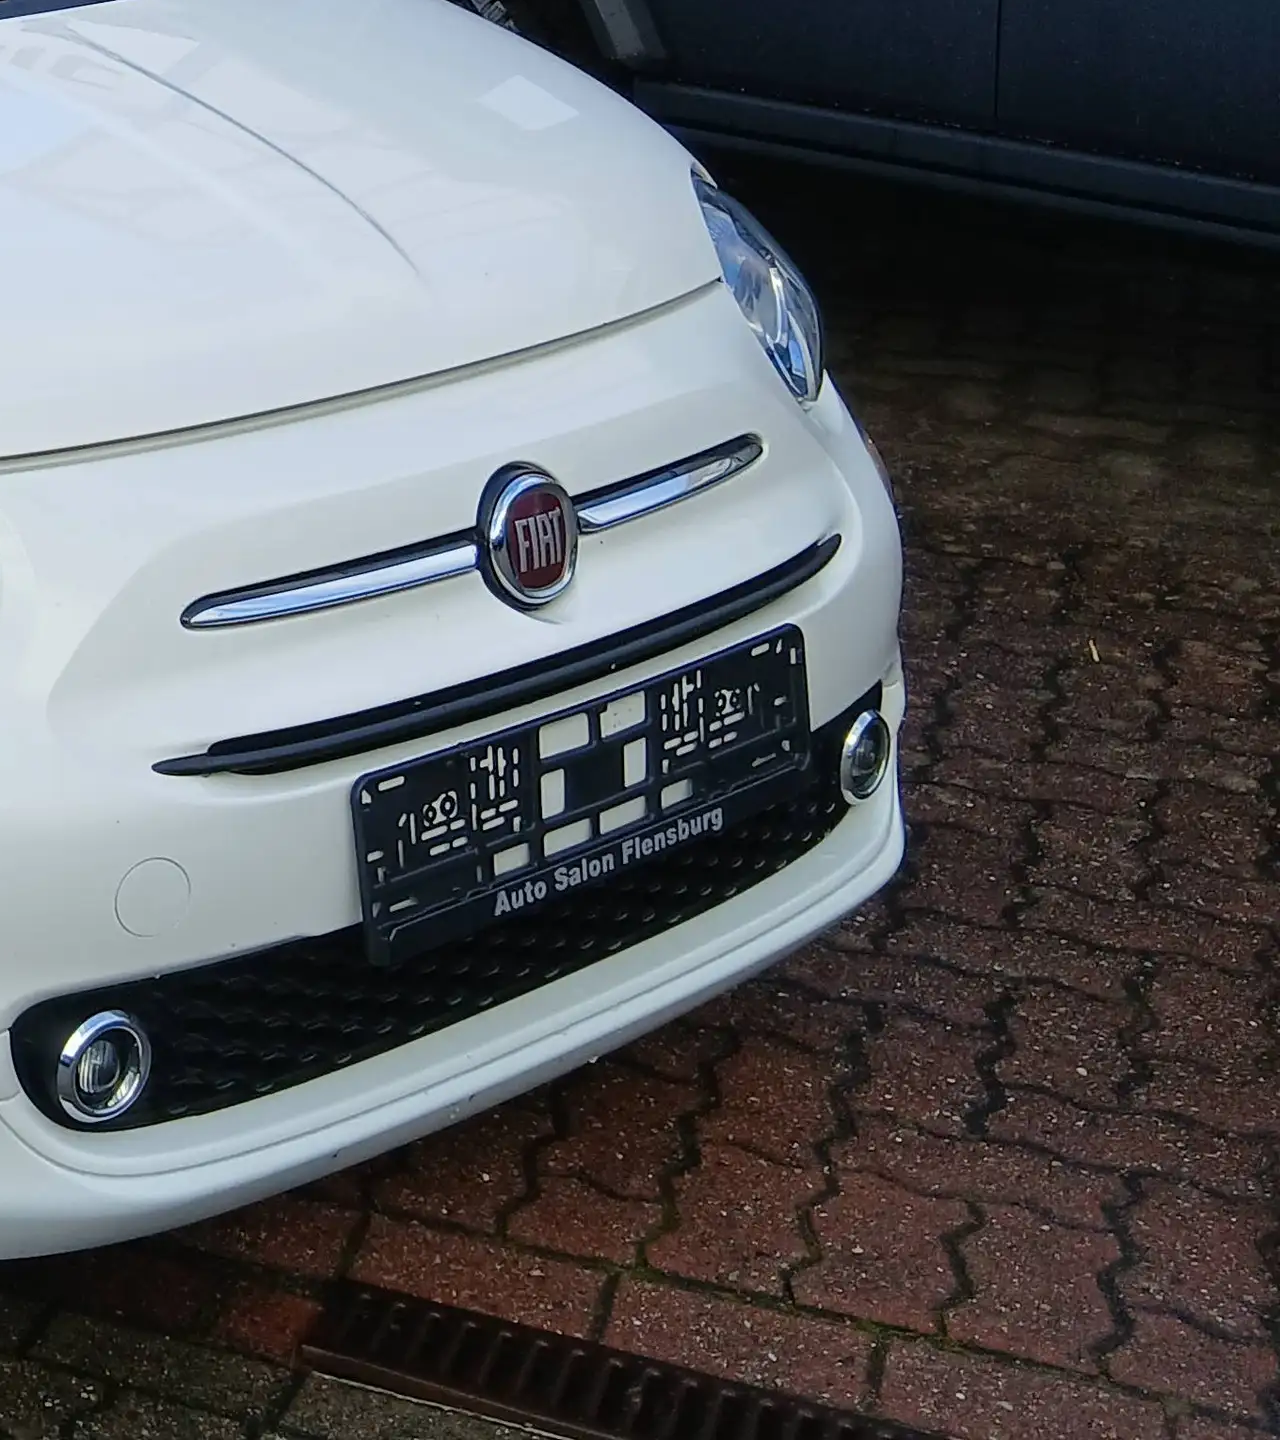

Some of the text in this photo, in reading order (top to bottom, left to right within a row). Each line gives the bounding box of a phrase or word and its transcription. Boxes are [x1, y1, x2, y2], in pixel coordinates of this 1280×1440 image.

[514, 506, 561, 573] FIAT
[494, 807, 723, 916] Auto Salon Flensburg
